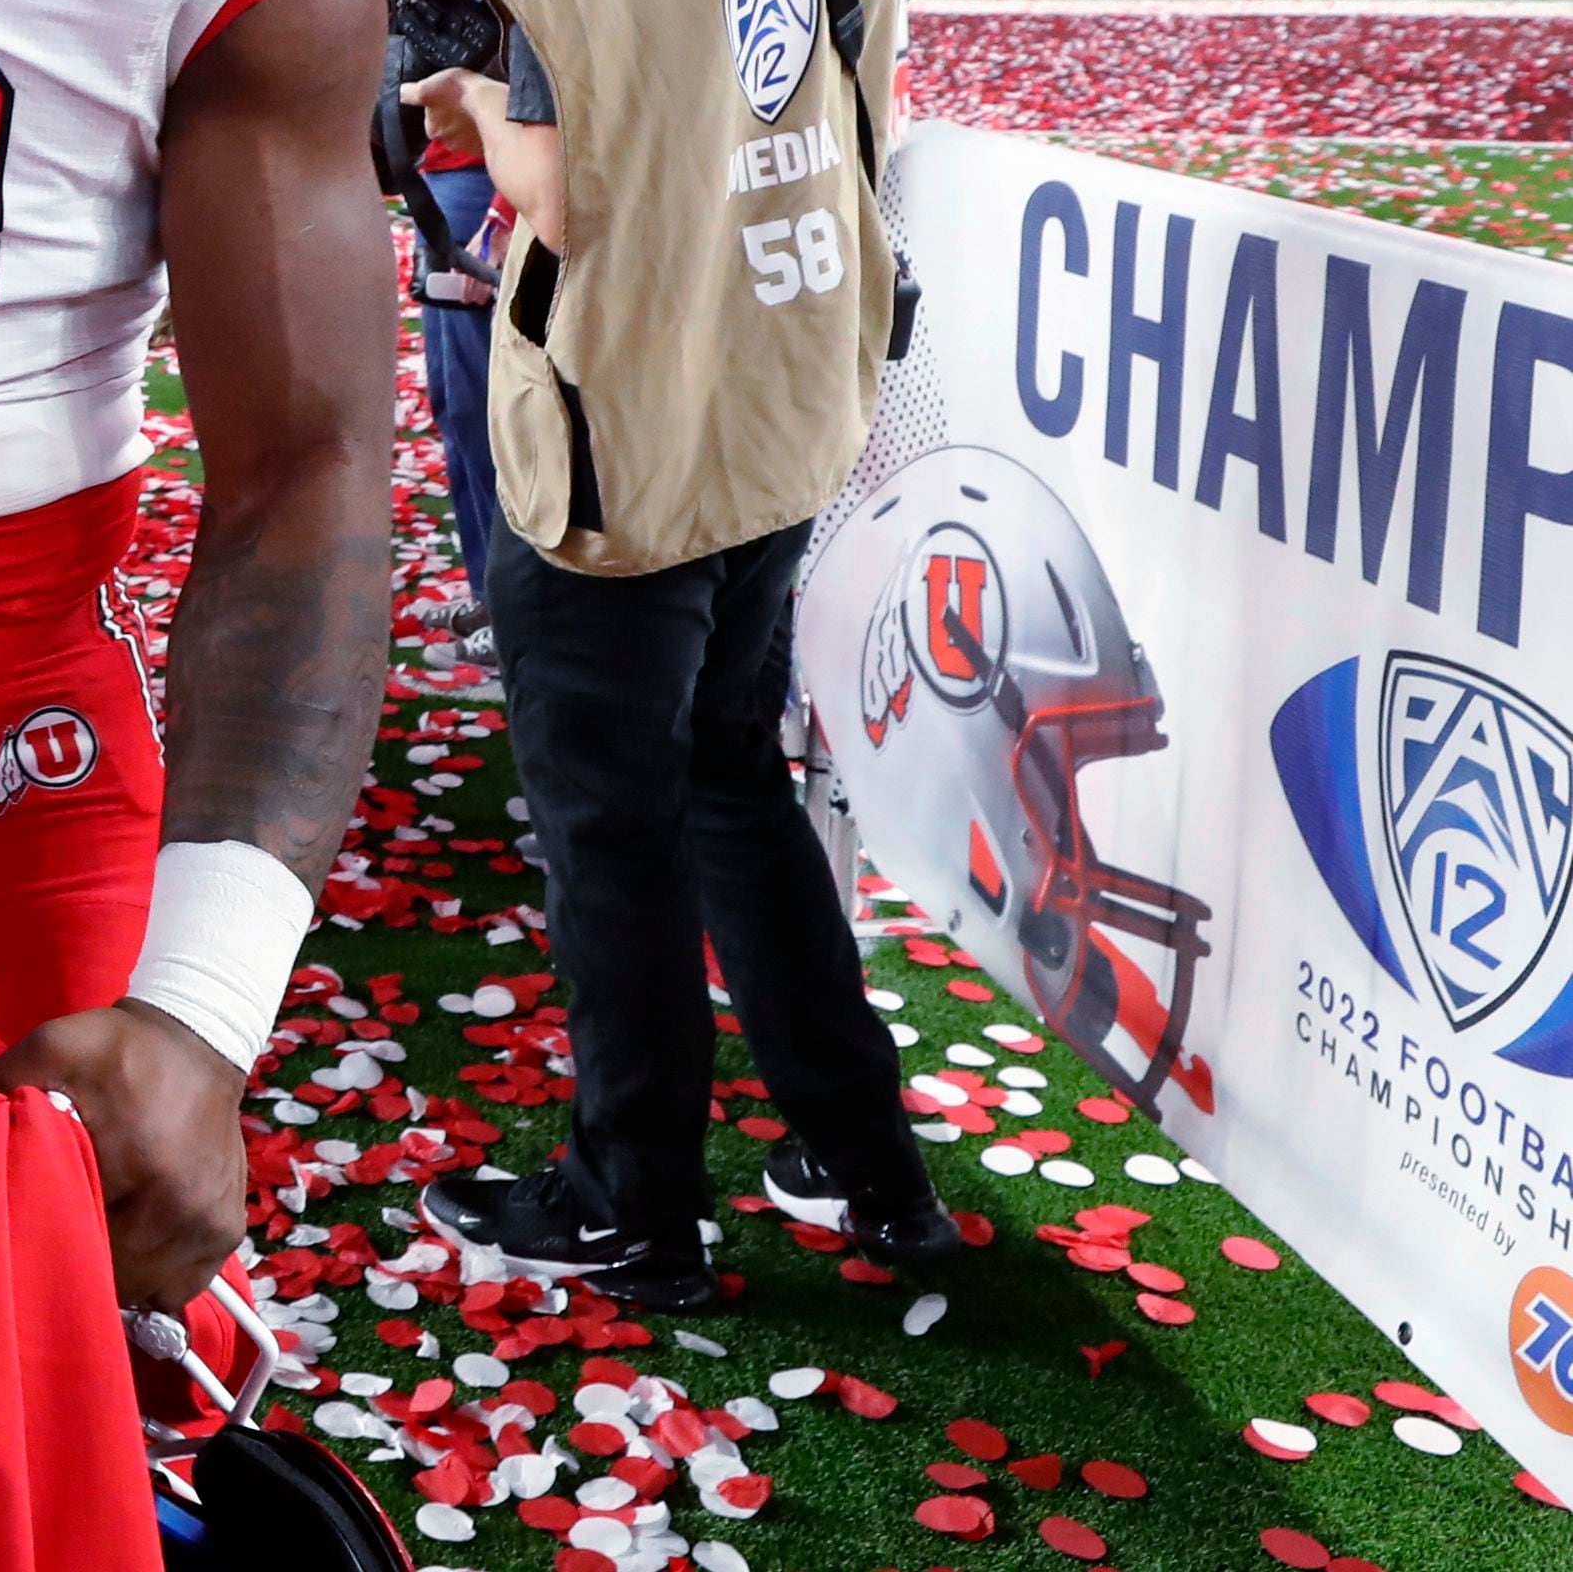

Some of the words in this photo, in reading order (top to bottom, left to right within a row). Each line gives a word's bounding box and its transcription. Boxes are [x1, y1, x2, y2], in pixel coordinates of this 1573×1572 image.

[754, 42, 790, 90] 12
[725, 118, 842, 201] MEDIA
[742, 207, 845, 306] 58
[1430, 851, 1507, 971] 12
[1298, 960, 1381, 1053] 2022
[1400, 1149, 1488, 1232] presented
[1493, 1220, 1517, 1257] by
